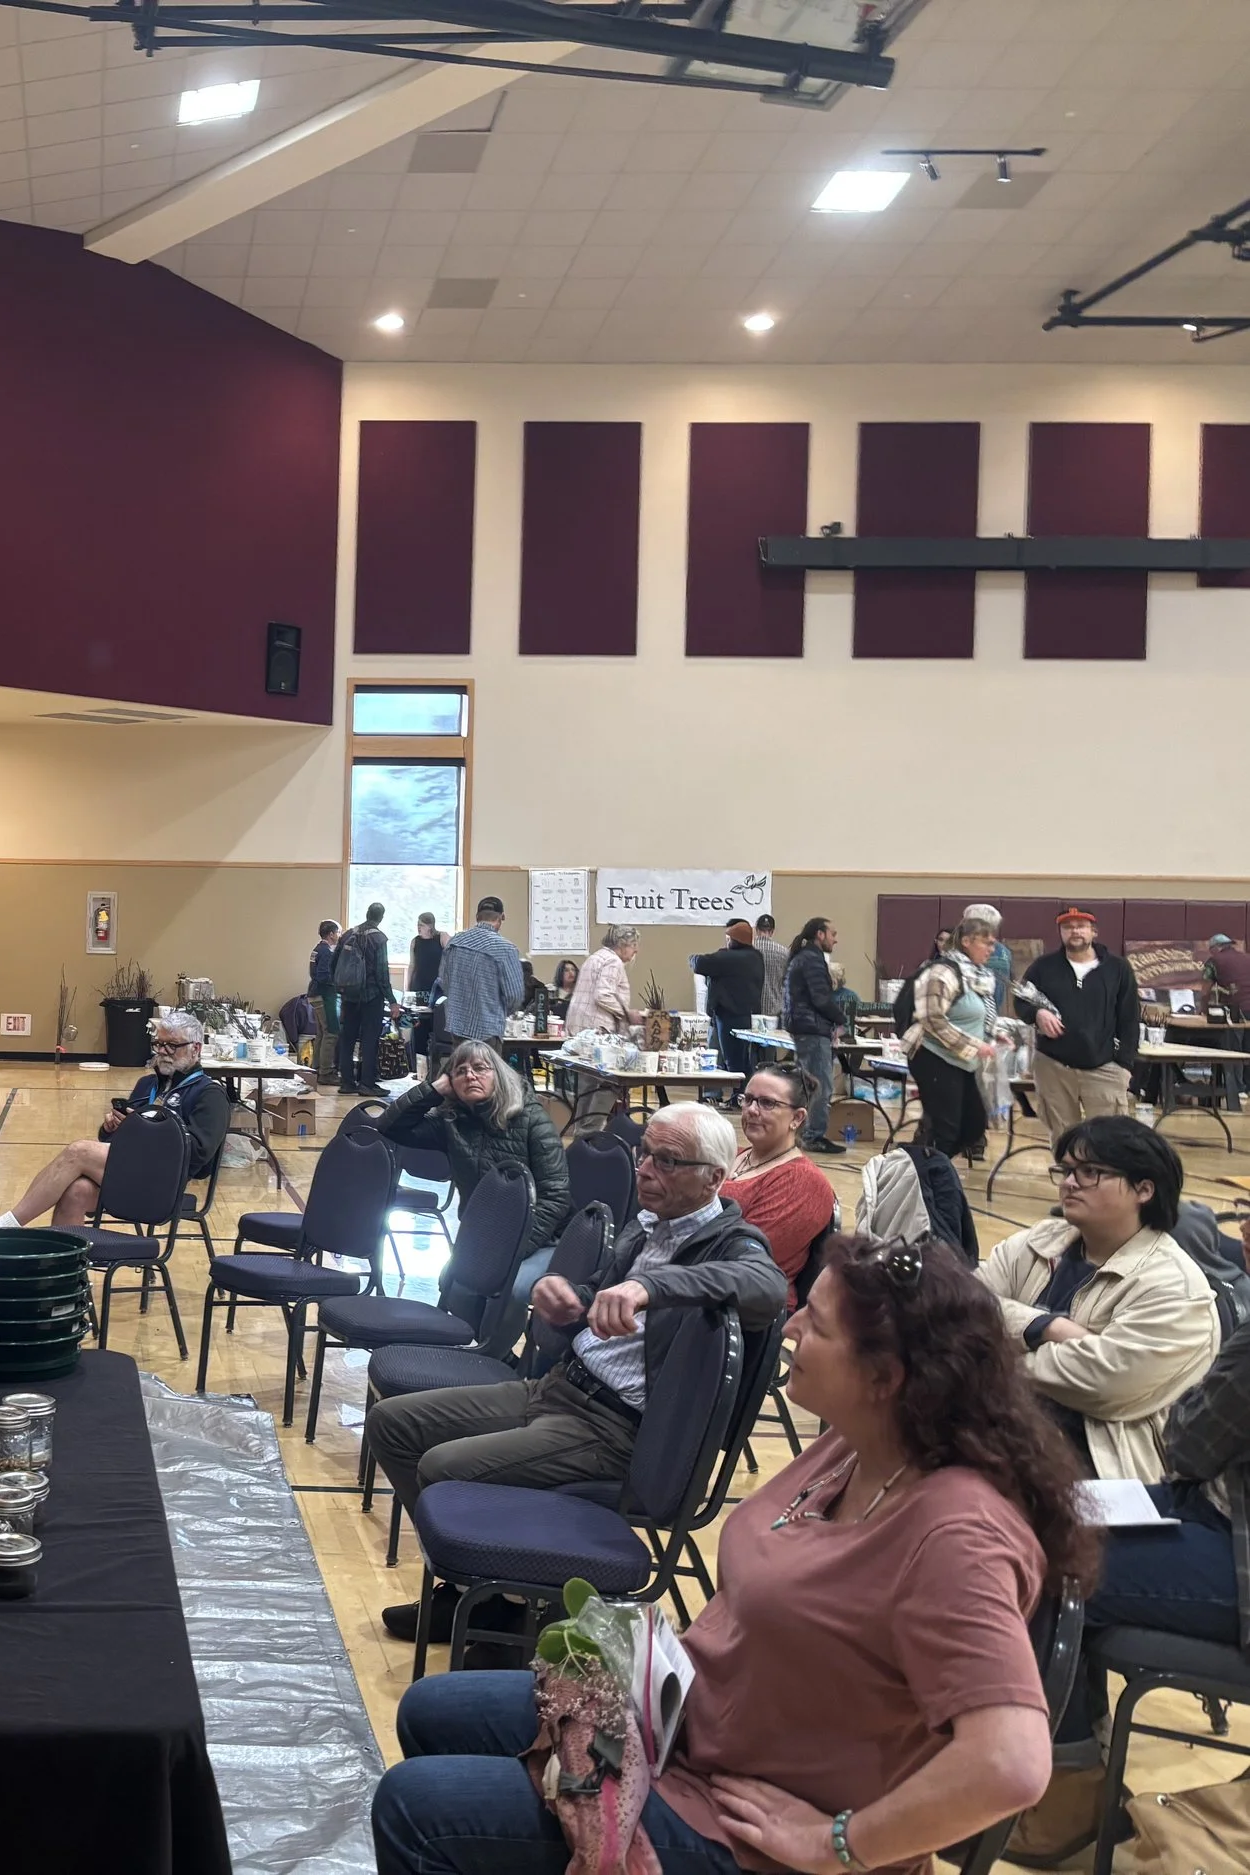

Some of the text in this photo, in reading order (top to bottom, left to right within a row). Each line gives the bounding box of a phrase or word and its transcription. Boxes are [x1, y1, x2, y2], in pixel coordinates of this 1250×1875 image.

[607, 887, 734, 911] Fruit Trees
[6, 1016, 26, 1031] EXIT
